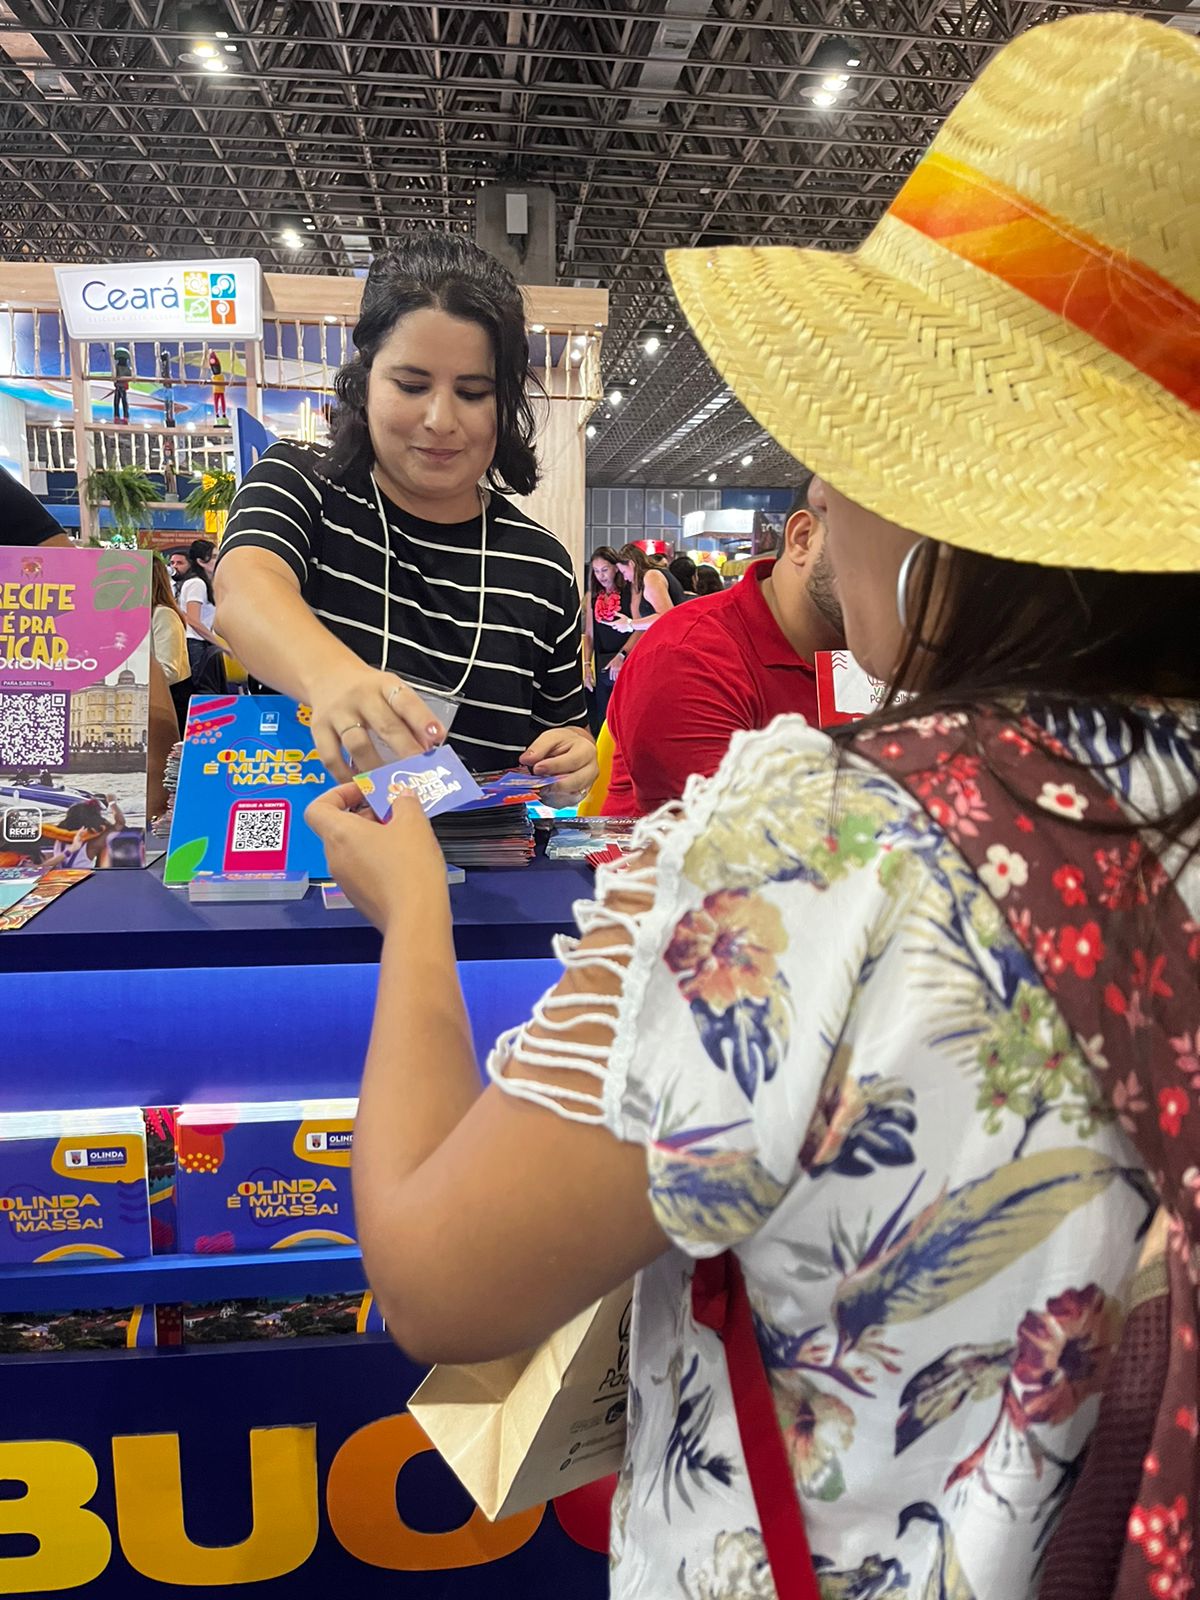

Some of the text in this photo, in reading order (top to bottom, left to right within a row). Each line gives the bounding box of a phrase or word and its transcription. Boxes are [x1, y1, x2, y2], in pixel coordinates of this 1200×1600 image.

[82, 277, 180, 311] Ceará
[0, 582, 76, 610] ECIFE
[3, 611, 57, 634] É PRA
[203, 760, 302, 775] É MUITO
[232, 773, 326, 785] MASSA!
[9, 828, 36, 836] RECIFE
[90, 1151, 124, 1159] OLINDA
[237, 1178, 337, 1196] OLINDA
[0, 1194, 101, 1211] OLINDA
[227, 1193, 316, 1208] É MUITO
[8, 1208, 79, 1221] MUITO
[255, 1203, 339, 1218] MASSA!
[16, 1217, 103, 1233] MASSA!
